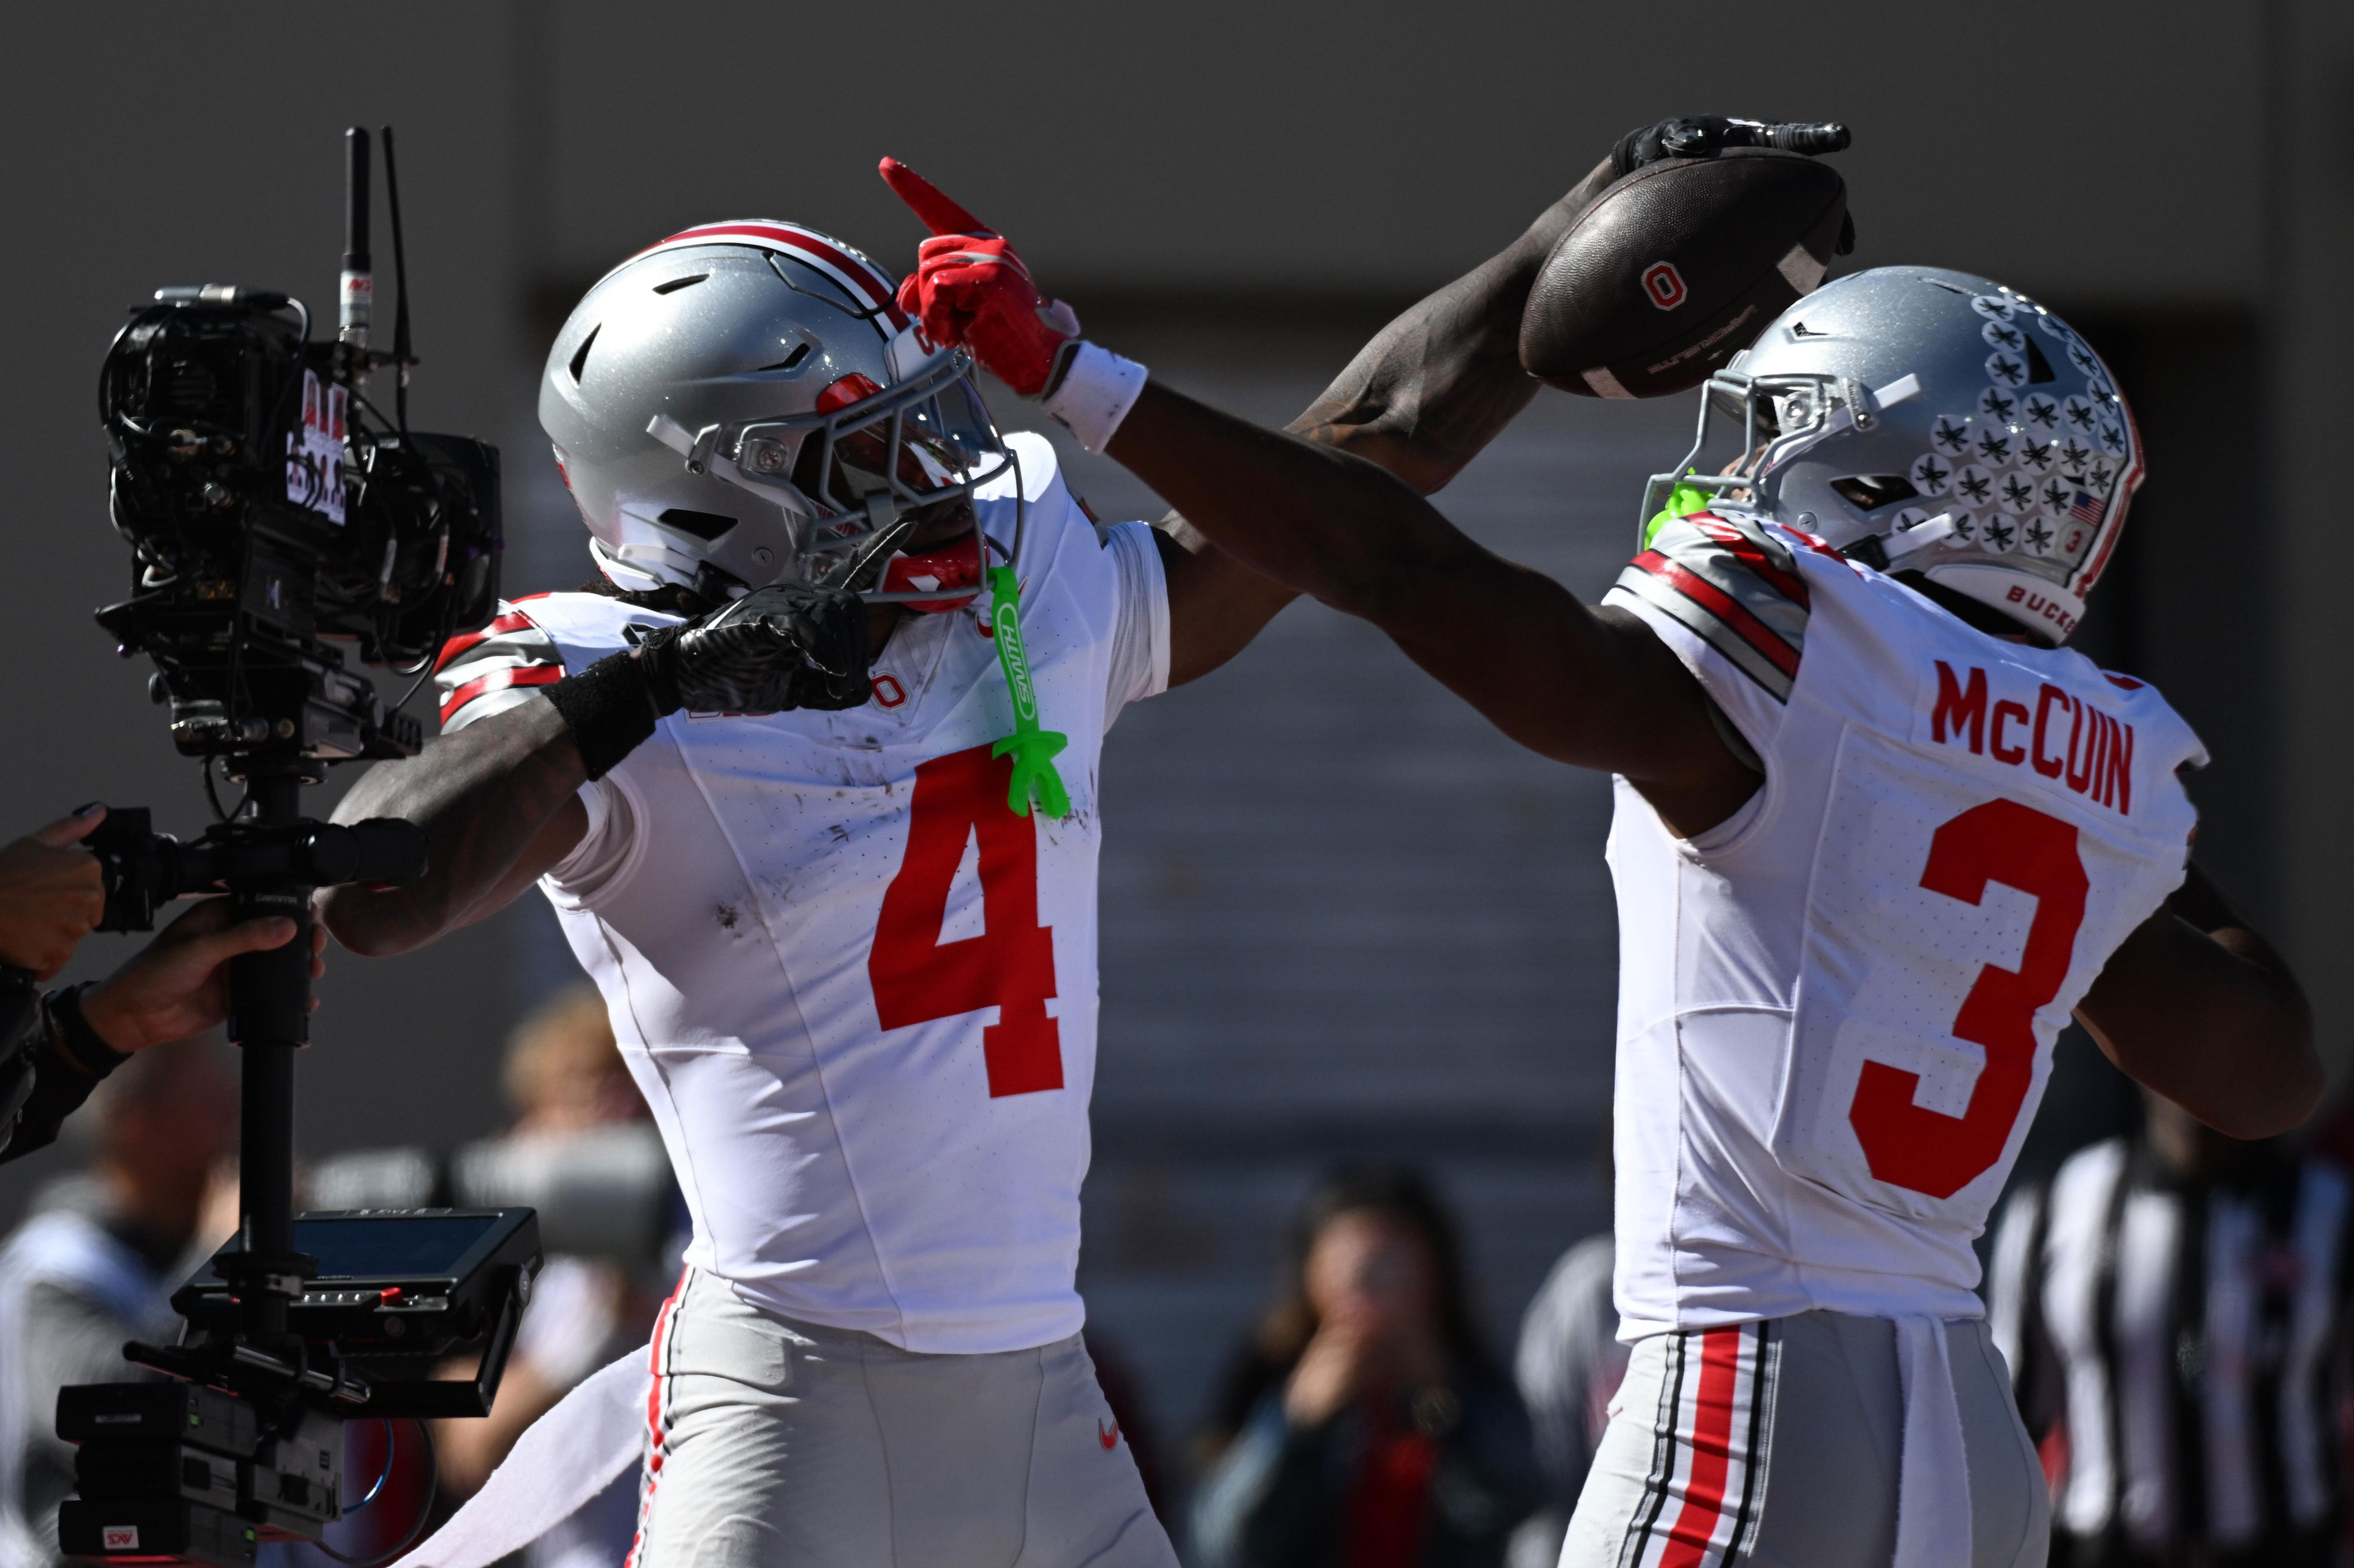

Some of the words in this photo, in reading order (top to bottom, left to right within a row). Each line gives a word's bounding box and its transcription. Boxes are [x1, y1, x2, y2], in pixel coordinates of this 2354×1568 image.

[1641, 261, 1687, 311] O
[2065, 530, 2083, 554] 3
[1931, 659, 2133, 816] McCUIN
[868, 741, 1064, 1099] 4
[1849, 797, 2090, 1199] 3
